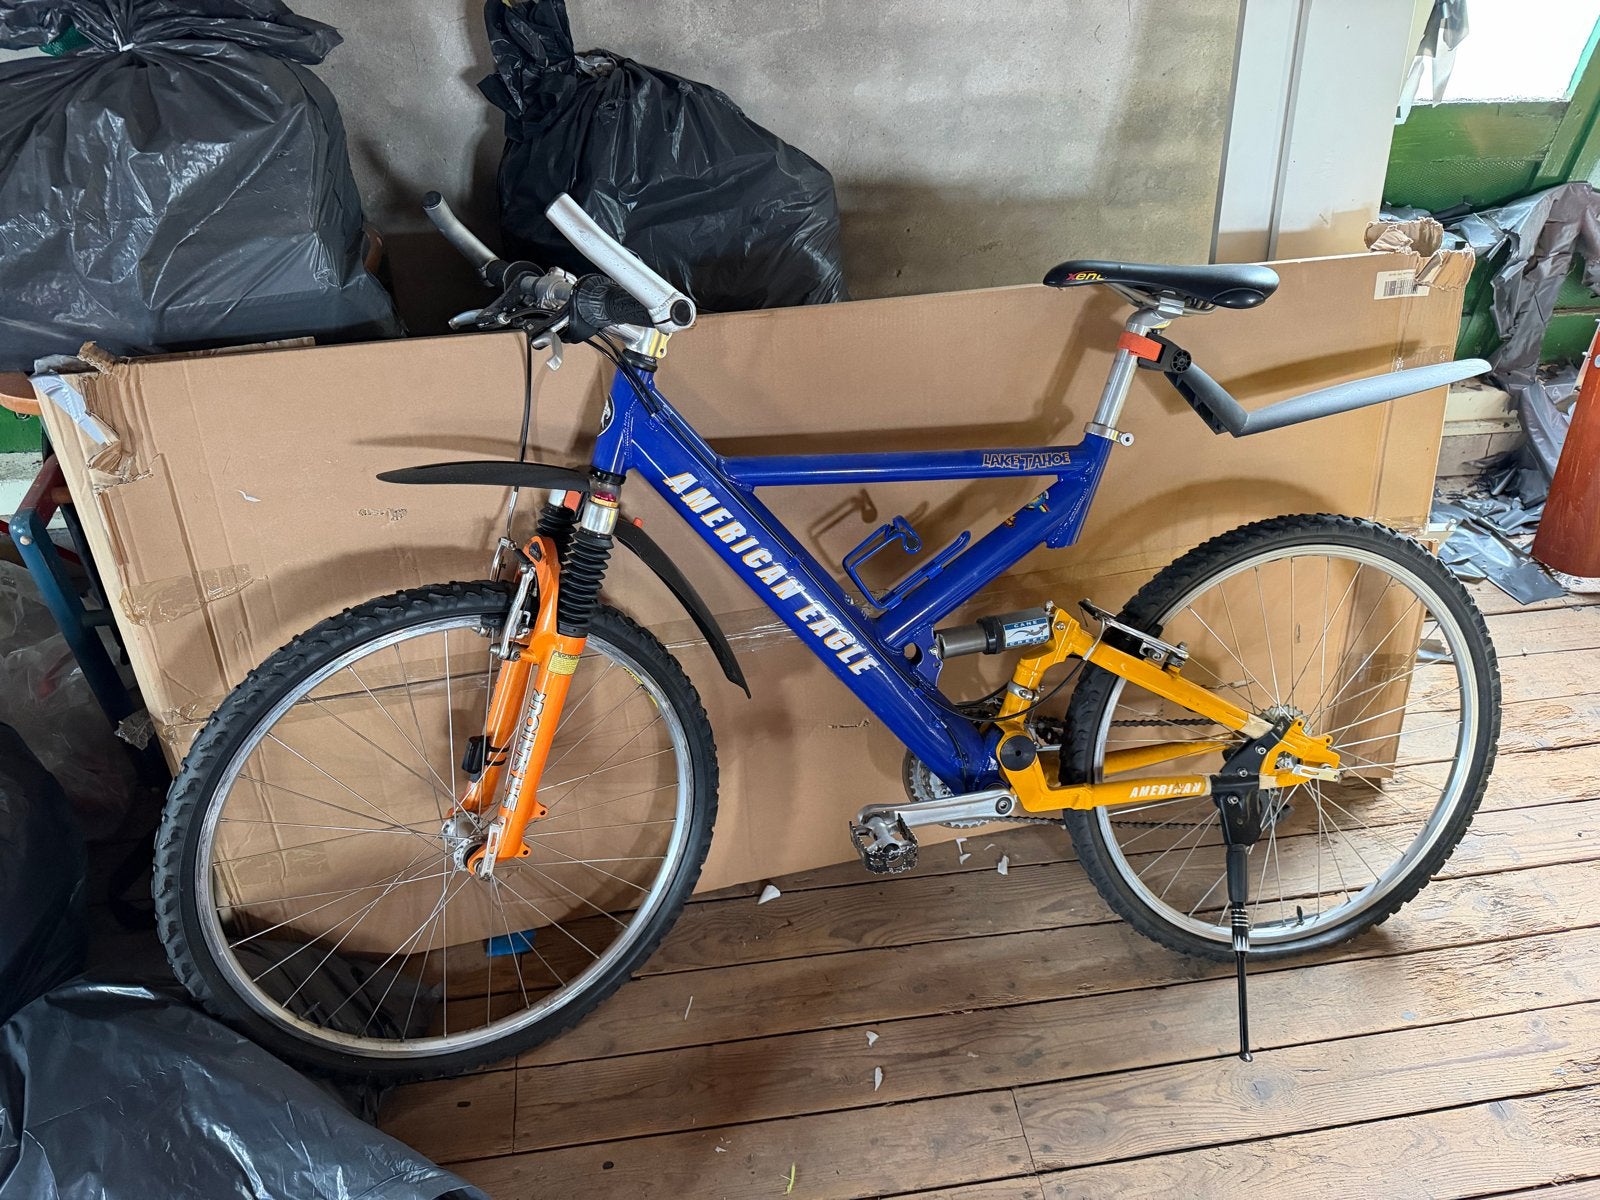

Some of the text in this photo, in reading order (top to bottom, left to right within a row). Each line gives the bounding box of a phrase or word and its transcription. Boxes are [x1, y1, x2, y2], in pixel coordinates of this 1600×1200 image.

[982, 452, 1070, 470] LAKE TAHOE
[662, 471, 880, 676] AMERICAN EAGLE
